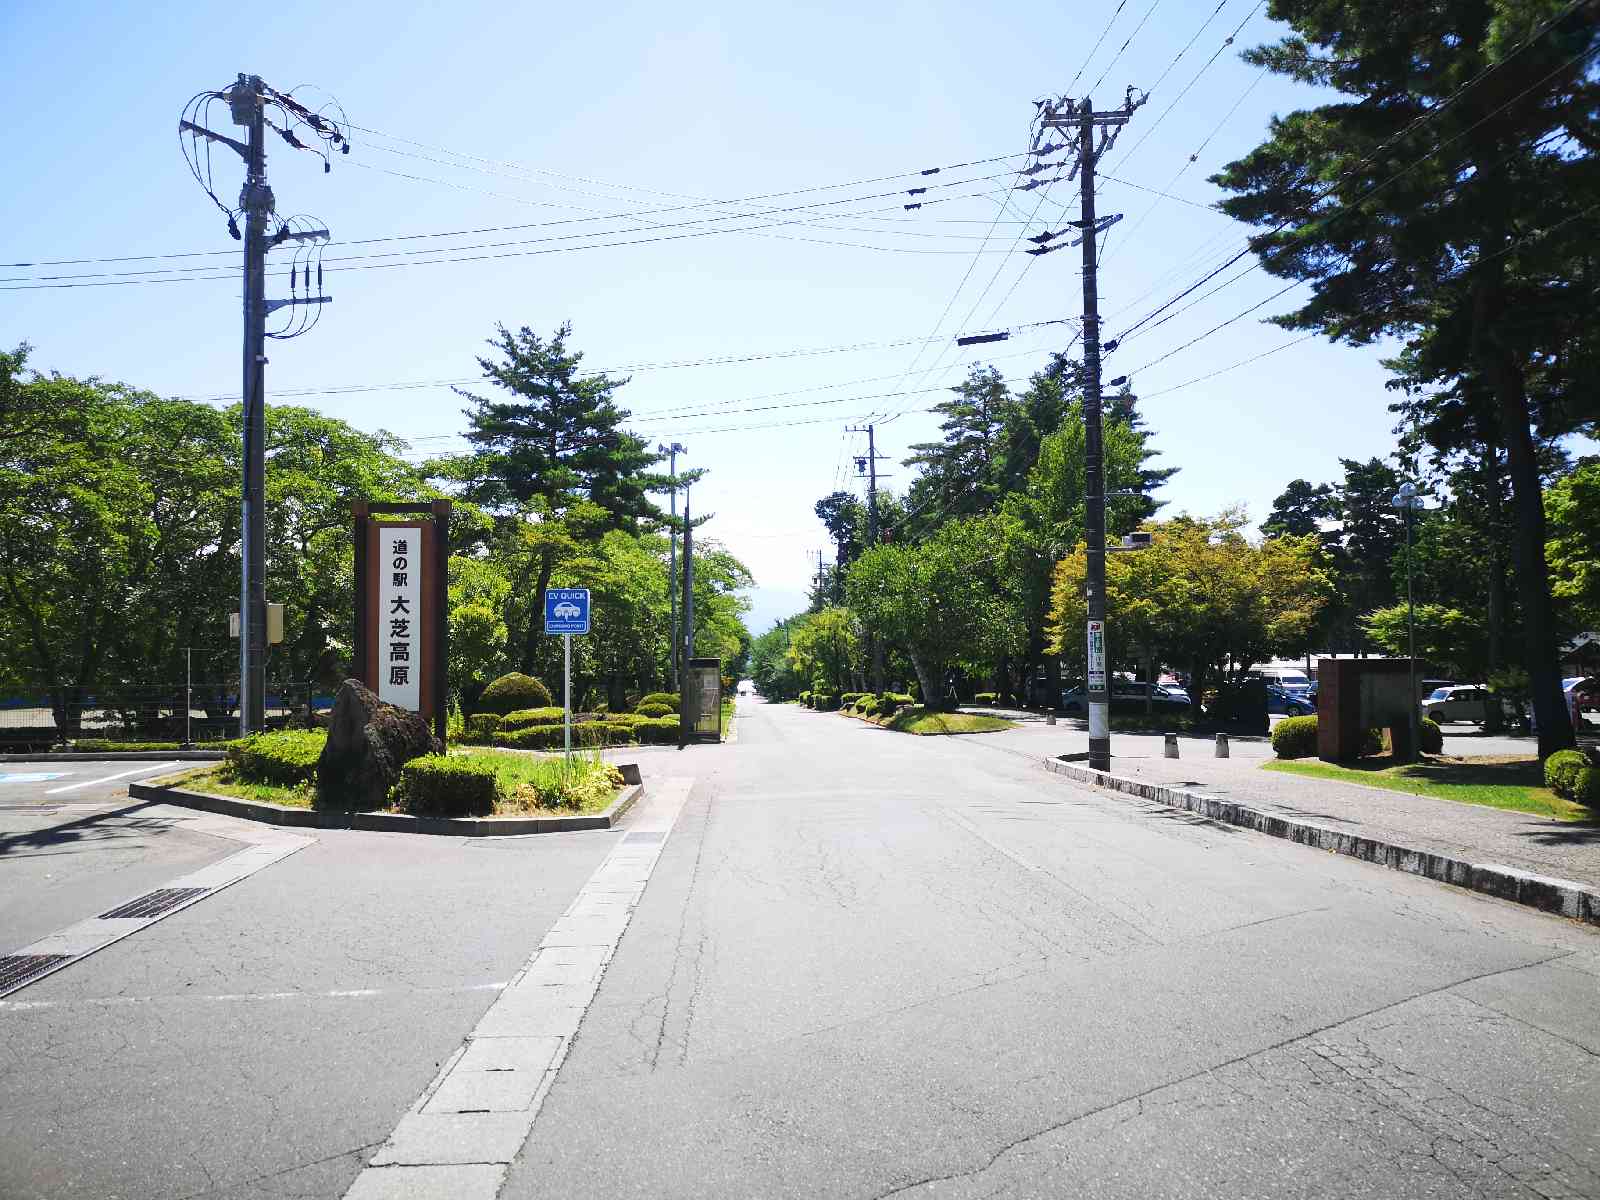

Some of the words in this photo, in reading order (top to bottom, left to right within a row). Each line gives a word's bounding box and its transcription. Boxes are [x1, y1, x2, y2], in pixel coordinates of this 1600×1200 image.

[392, 539, 408, 587] 道の駅
[548, 592, 559, 600] EV
[560, 592, 586, 600] QUICK
[389, 595, 410, 685] 大芝高原
